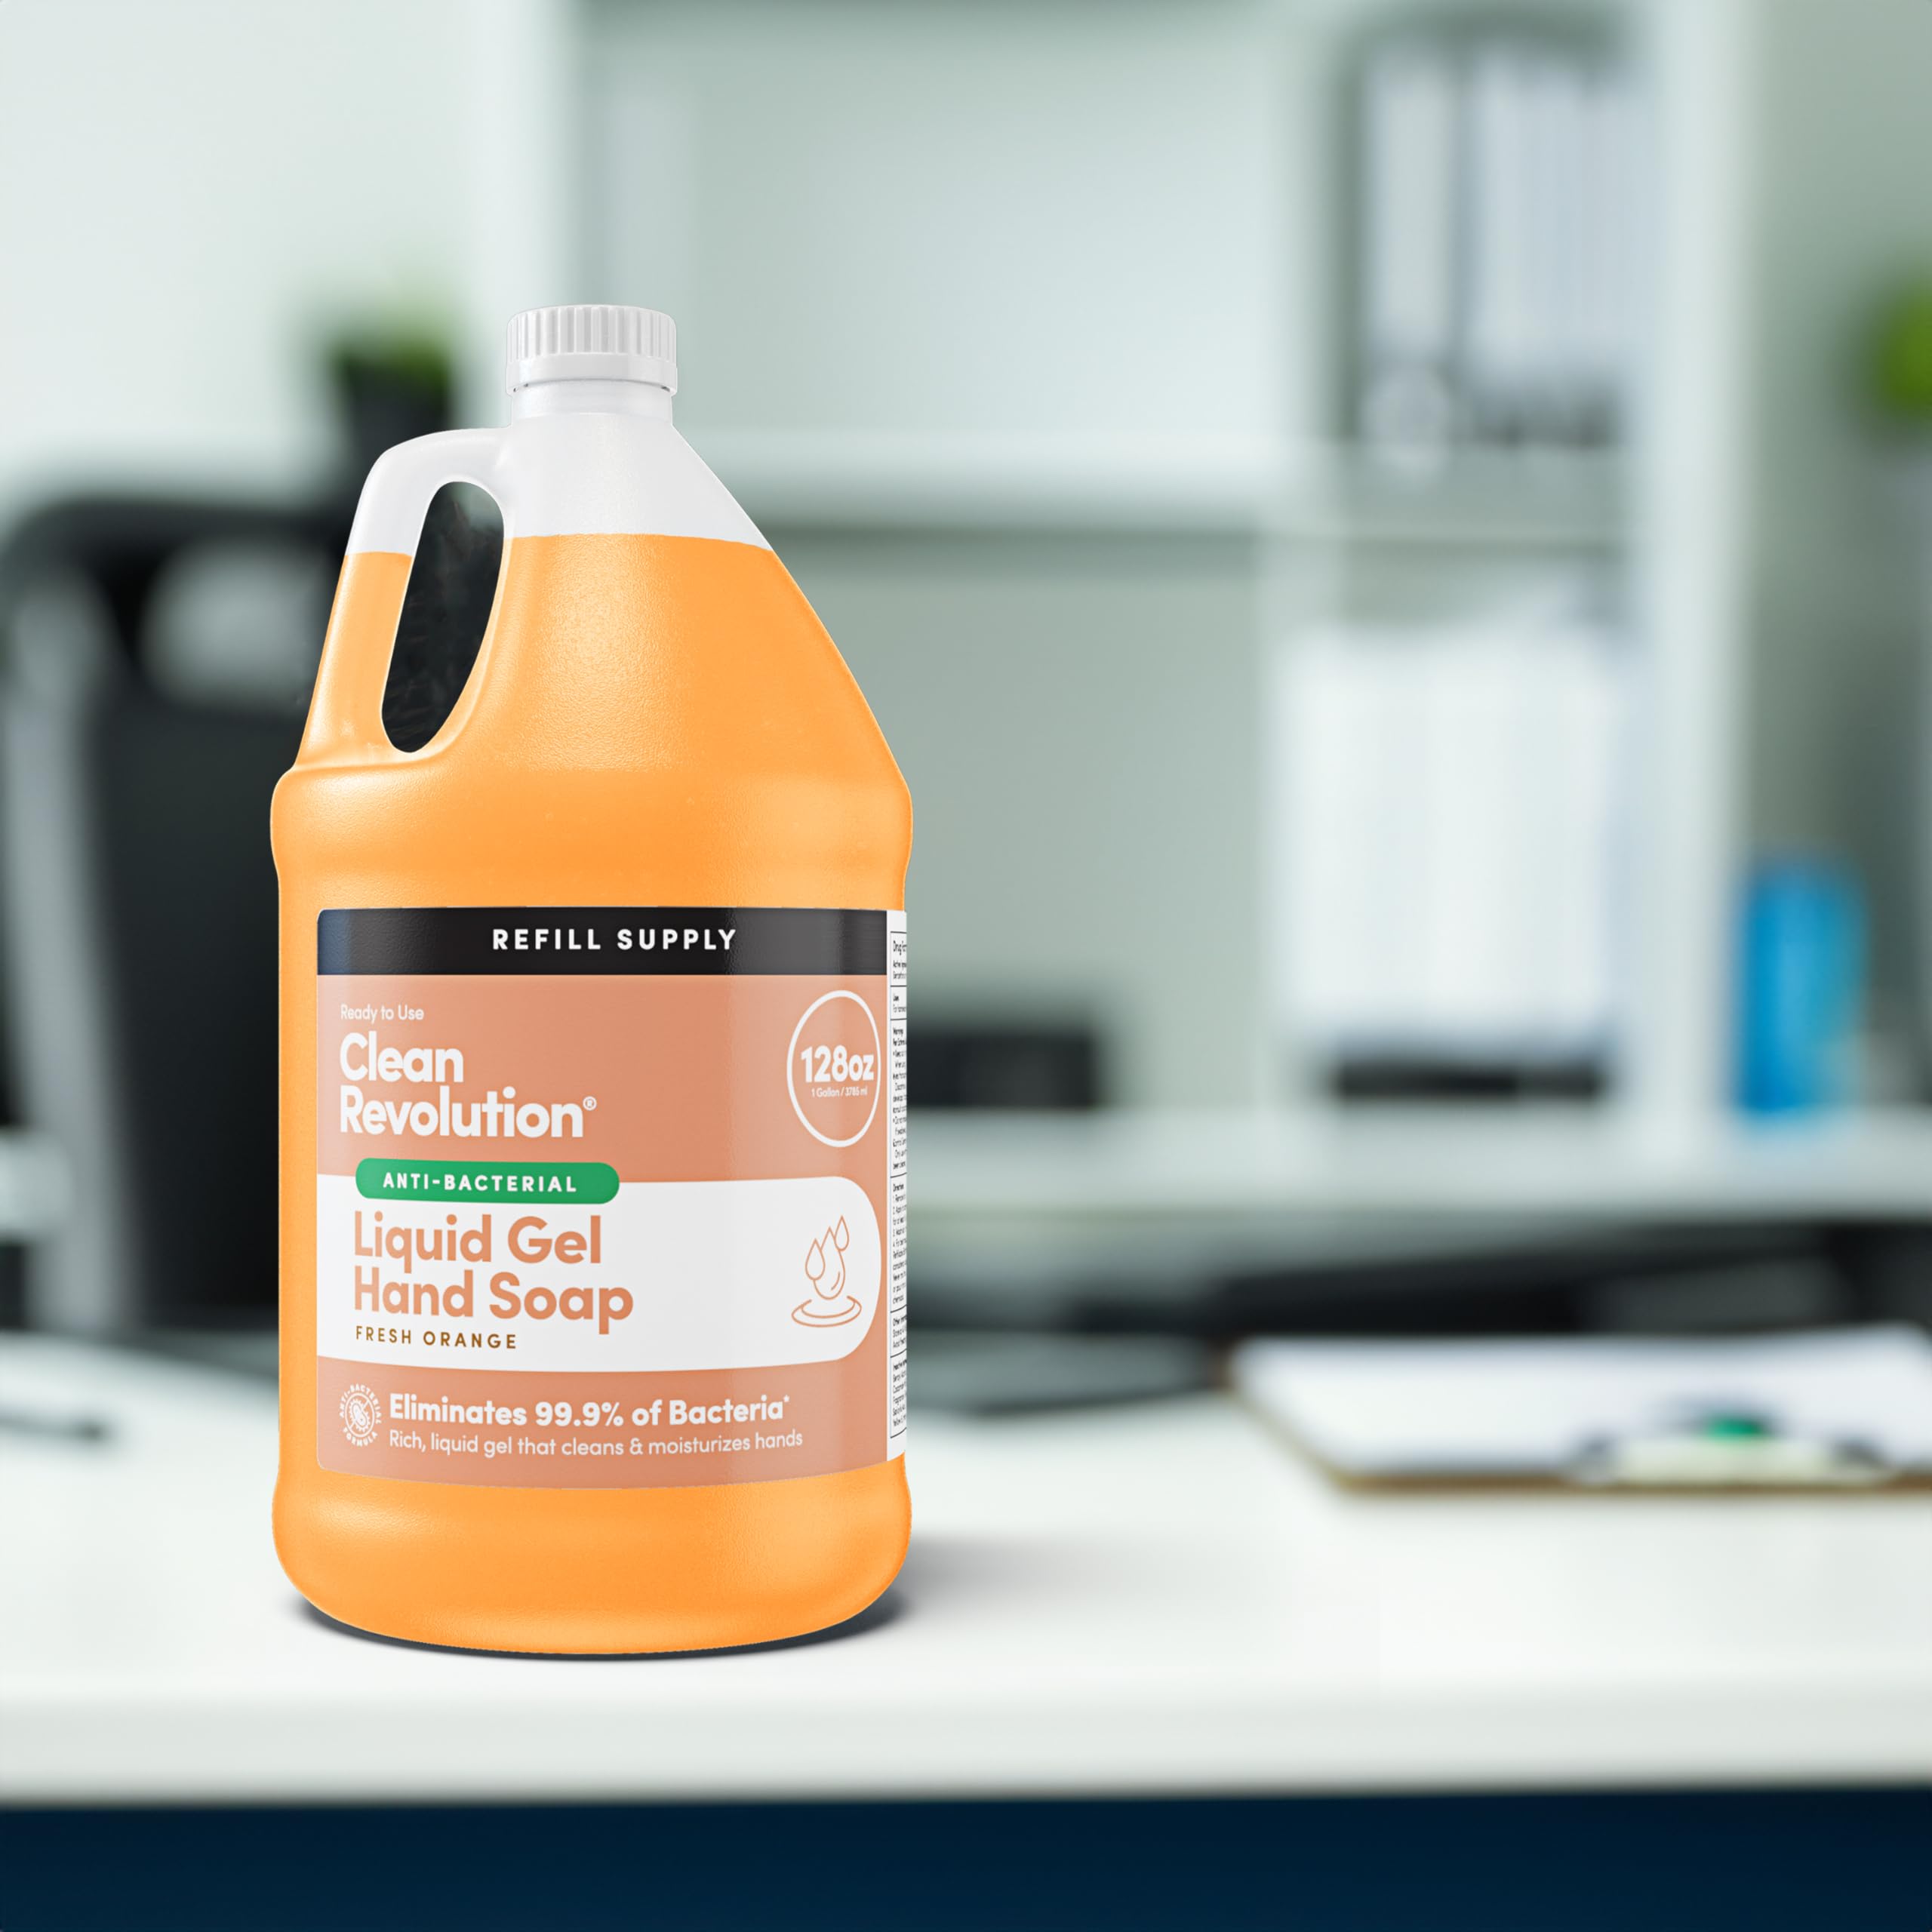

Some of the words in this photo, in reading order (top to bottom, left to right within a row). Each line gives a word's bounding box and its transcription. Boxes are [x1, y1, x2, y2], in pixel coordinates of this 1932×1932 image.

[493, 928, 601, 950] REFILL
[617, 928, 736, 950] SUPPLY
[340, 1002, 378, 1024] Ready
[380, 1005, 395, 1020] to
[398, 1004, 424, 1021] Use
[340, 1031, 463, 1082] Clean
[801, 1044, 875, 1083] 128oz
[811, 1088, 816, 1097] 1
[817, 1088, 840, 1098] Gallon
[383, 1171, 577, 1192] ANTI-BACTERIAL
[355, 1211, 492, 1274] Liquid
[507, 1214, 601, 1264] Gel
[355, 1266, 474, 1318] Hand
[488, 1272, 633, 1335] Soap
[355, 1325, 411, 1344] FRESH
[423, 1331, 516, 1349] ORANGE
[389, 1392, 528, 1426] Eliminates
[535, 1401, 624, 1427] 99.9%
[632, 1399, 663, 1426] of
[389, 1429, 426, 1453] Rich,
[430, 1432, 478, 1456] liquid
[483, 1436, 512, 1459] gel
[517, 1436, 556, 1455] that
[561, 1436, 624, 1456] cleans
[629, 1437, 644, 1456] &
[648, 1435, 751, 1455] moisturizes
[755, 1429, 803, 1450] hands
